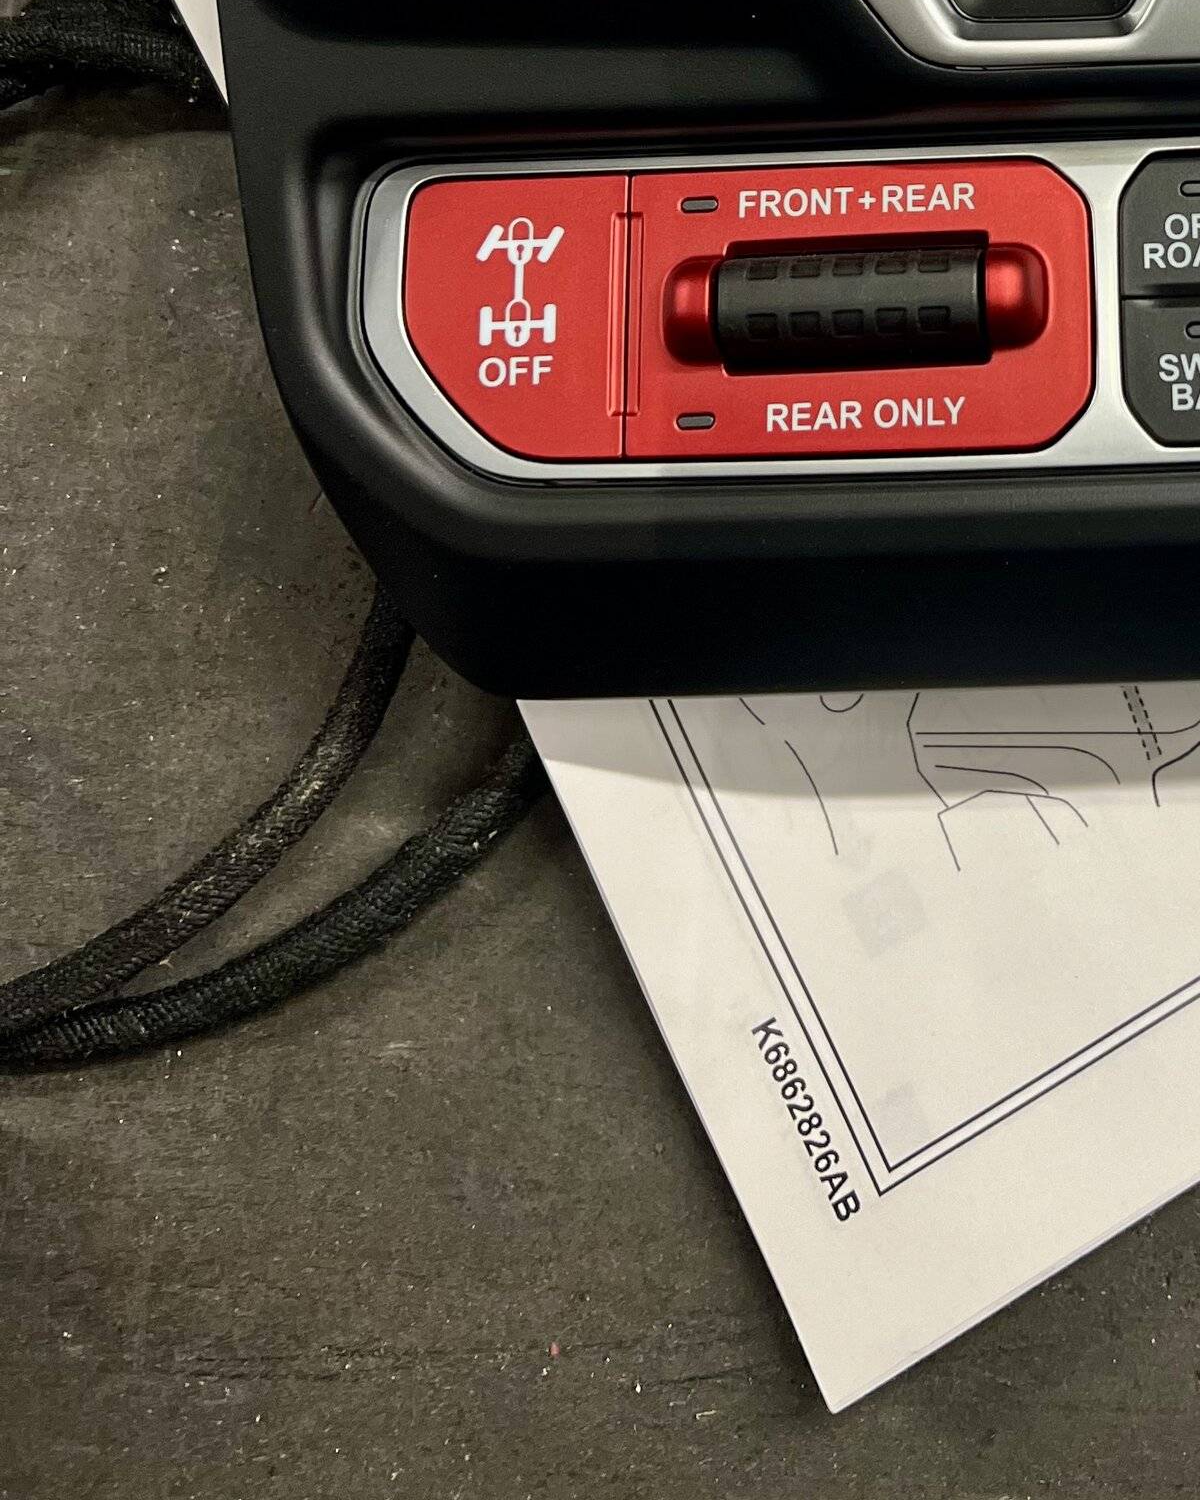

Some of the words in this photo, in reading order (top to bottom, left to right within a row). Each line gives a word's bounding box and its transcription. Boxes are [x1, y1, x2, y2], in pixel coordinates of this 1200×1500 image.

[478, 354, 554, 388] OFF
[765, 402, 865, 433] REAR
[873, 395, 967, 430] ONLY
[751, 1017, 862, 1222] K6862826AB
